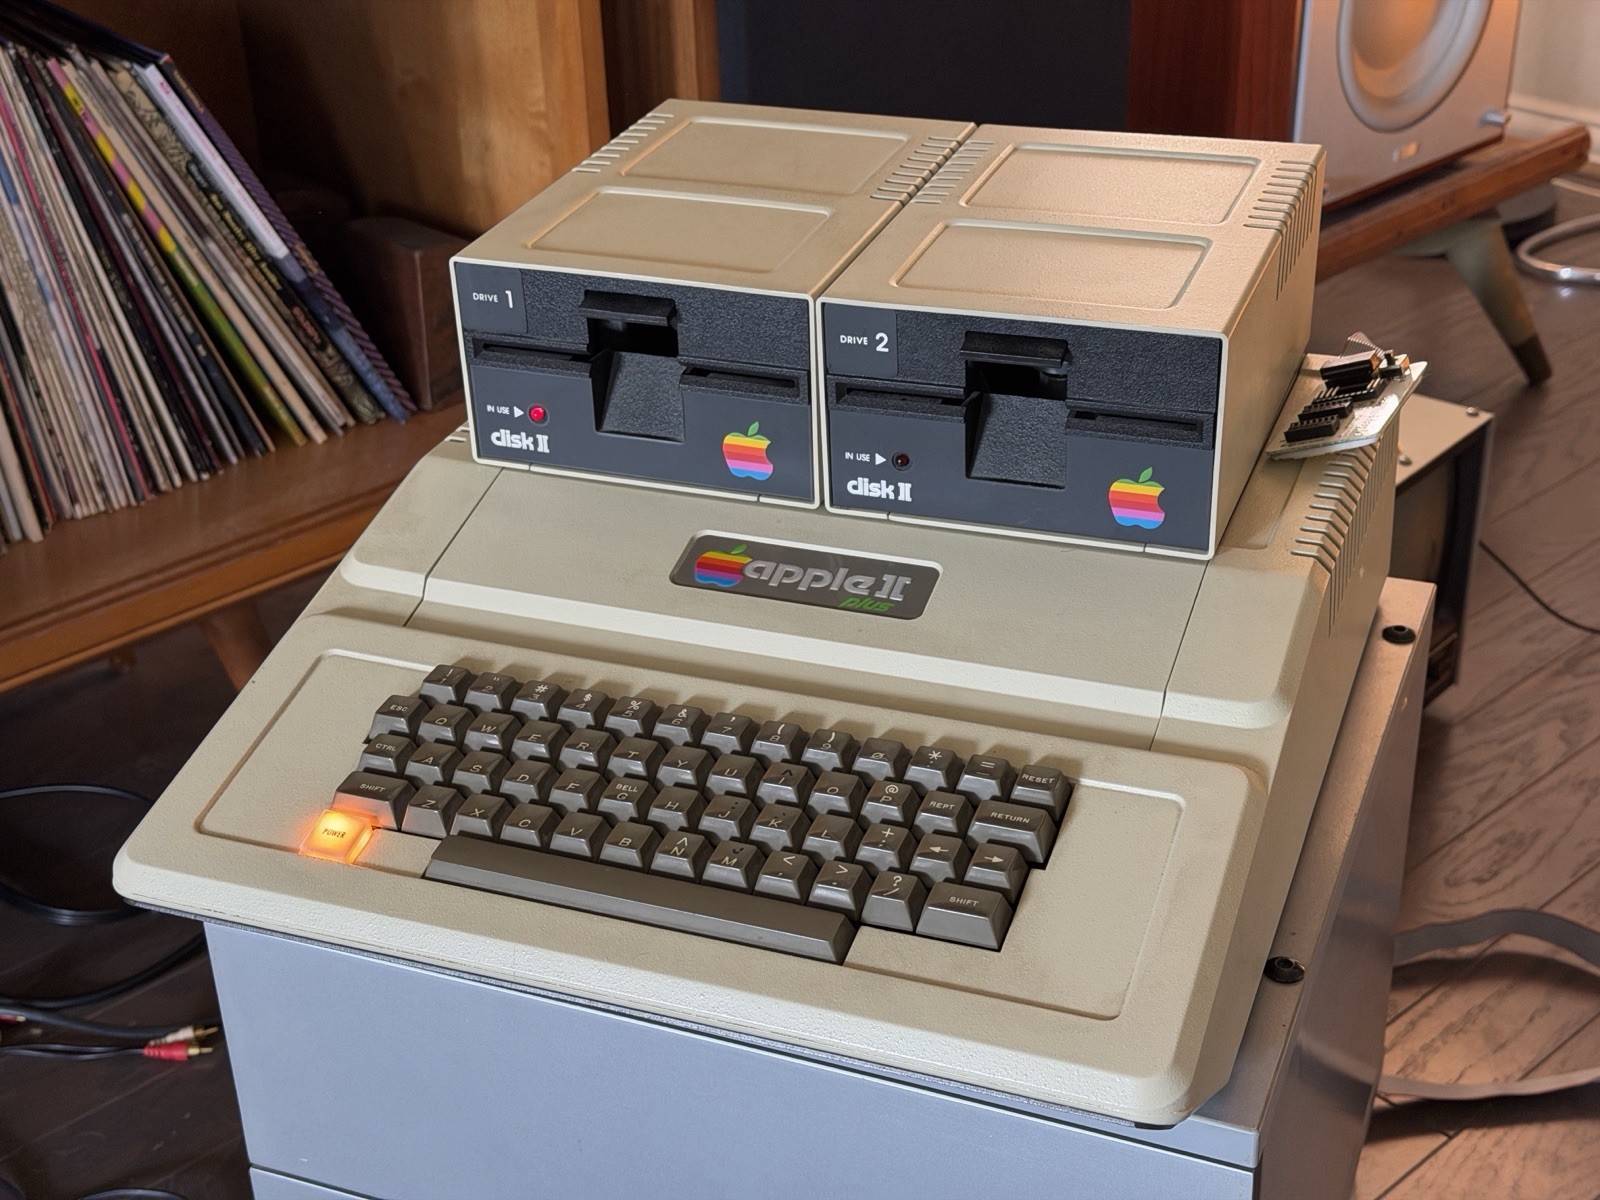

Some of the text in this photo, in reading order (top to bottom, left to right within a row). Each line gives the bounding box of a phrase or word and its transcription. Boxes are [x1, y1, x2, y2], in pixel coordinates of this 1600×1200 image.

[472, 291, 513, 308] DRIVE 1
[839, 332, 890, 353] DRIVE 2
[487, 405, 510, 415] IN USE
[490, 429, 534, 451] disk
[845, 452, 871, 463] IN USE
[846, 476, 895, 500] disk
[743, 561, 876, 594] apple
[838, 597, 893, 612] plus
[534, 684, 548, 694] #
[583, 693, 593, 703] $
[389, 703, 408, 712] ESC
[574, 702, 585, 710] 4
[631, 700, 642, 711] %
[677, 708, 688, 718] &
[435, 717, 447, 727] Q
[481, 724, 497, 733] W
[528, 734, 541, 742] E
[375, 742, 397, 752] CTRL
[578, 742, 590, 750] R
[628, 750, 639, 759] T
[422, 756, 434, 765] A
[676, 759, 689, 768] Y
[470, 764, 483, 773] S
[724, 768, 738, 777] U
[516, 774, 530, 782] D
[1021, 773, 1054, 784] RESET
[359, 783, 386, 793] SHIFT
[565, 782, 580, 791] F
[615, 783, 638, 793] BELL
[885, 784, 899, 795] @
[880, 795, 892, 803] P
[421, 800, 437, 808] Z
[665, 801, 679, 810] H
[929, 800, 956, 811] REPT
[469, 808, 485, 817] X
[719, 810, 731, 818] J
[990, 811, 1030, 824] RETURN
[518, 819, 532, 828] C
[768, 818, 782, 827] K
[321, 828, 347, 838] POWER
[570, 827, 583, 836] V
[820, 830, 831, 838] L
[882, 828, 894, 838] +
[619, 838, 632, 846] B
[670, 847, 684, 855] N
[721, 857, 738, 866] M
[893, 875, 902, 887] ?
[949, 896, 979, 907] SHIFT
